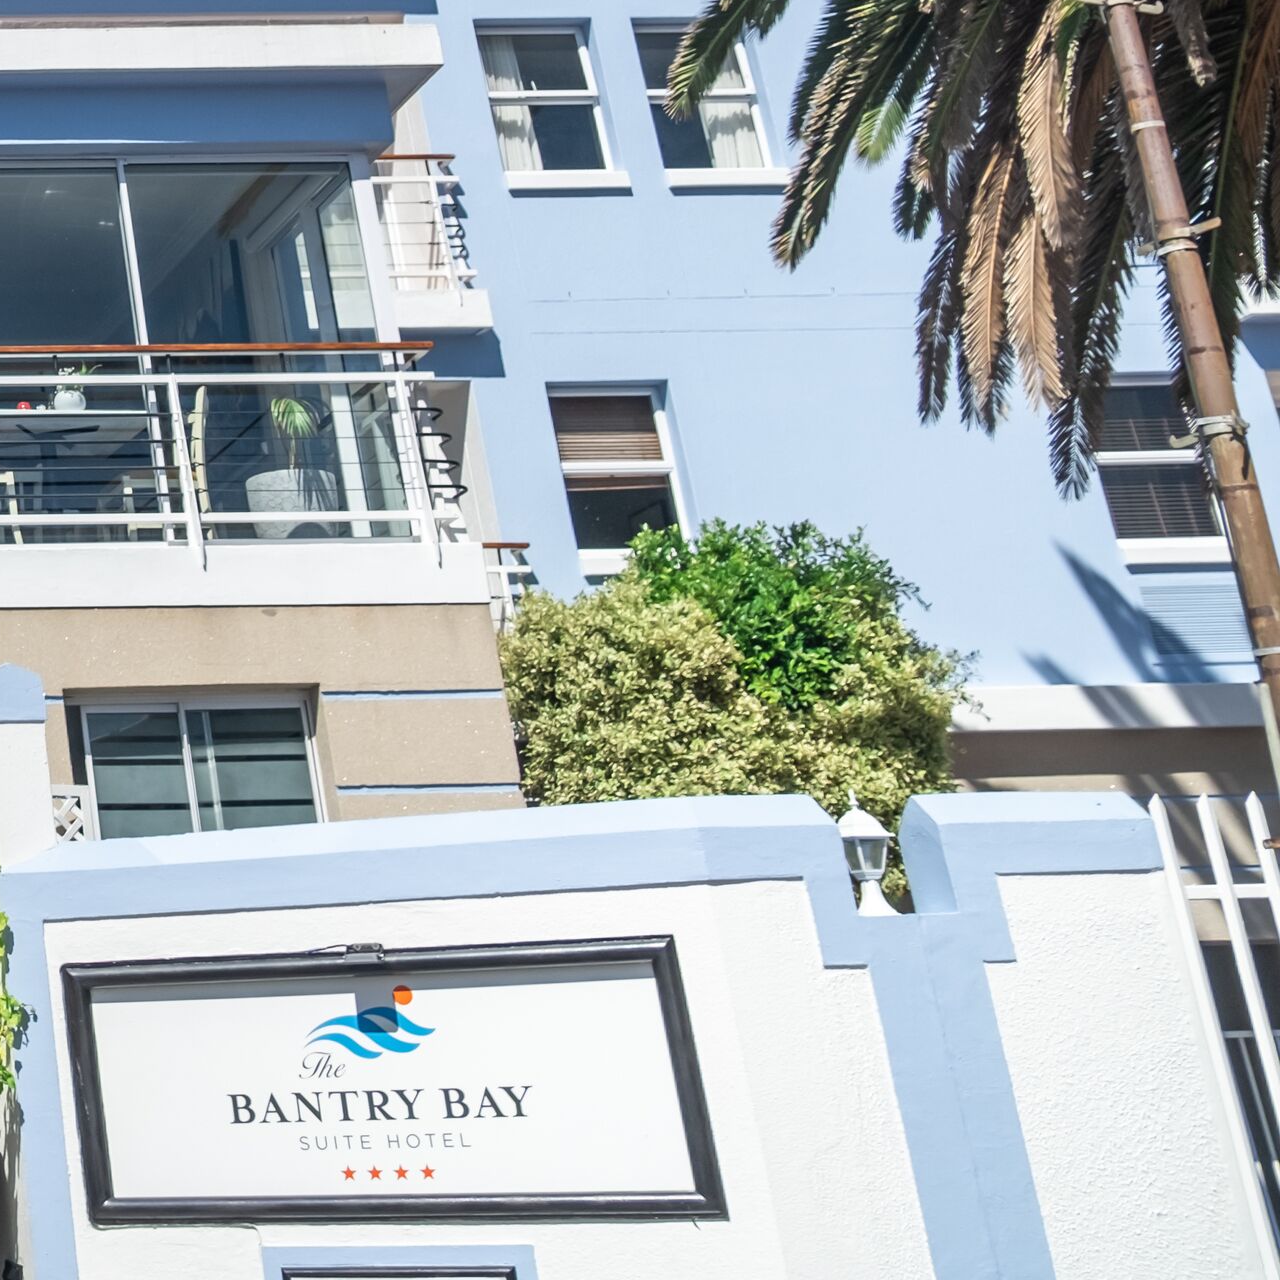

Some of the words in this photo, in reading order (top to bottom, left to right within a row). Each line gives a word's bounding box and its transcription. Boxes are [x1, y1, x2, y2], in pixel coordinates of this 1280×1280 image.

[298, 1051, 348, 1079] The
[226, 1088, 425, 1125] BANTRY
[438, 1085, 533, 1120] BAY
[299, 1134, 372, 1151] SUITE
[386, 1132, 472, 1150] HOTEL
